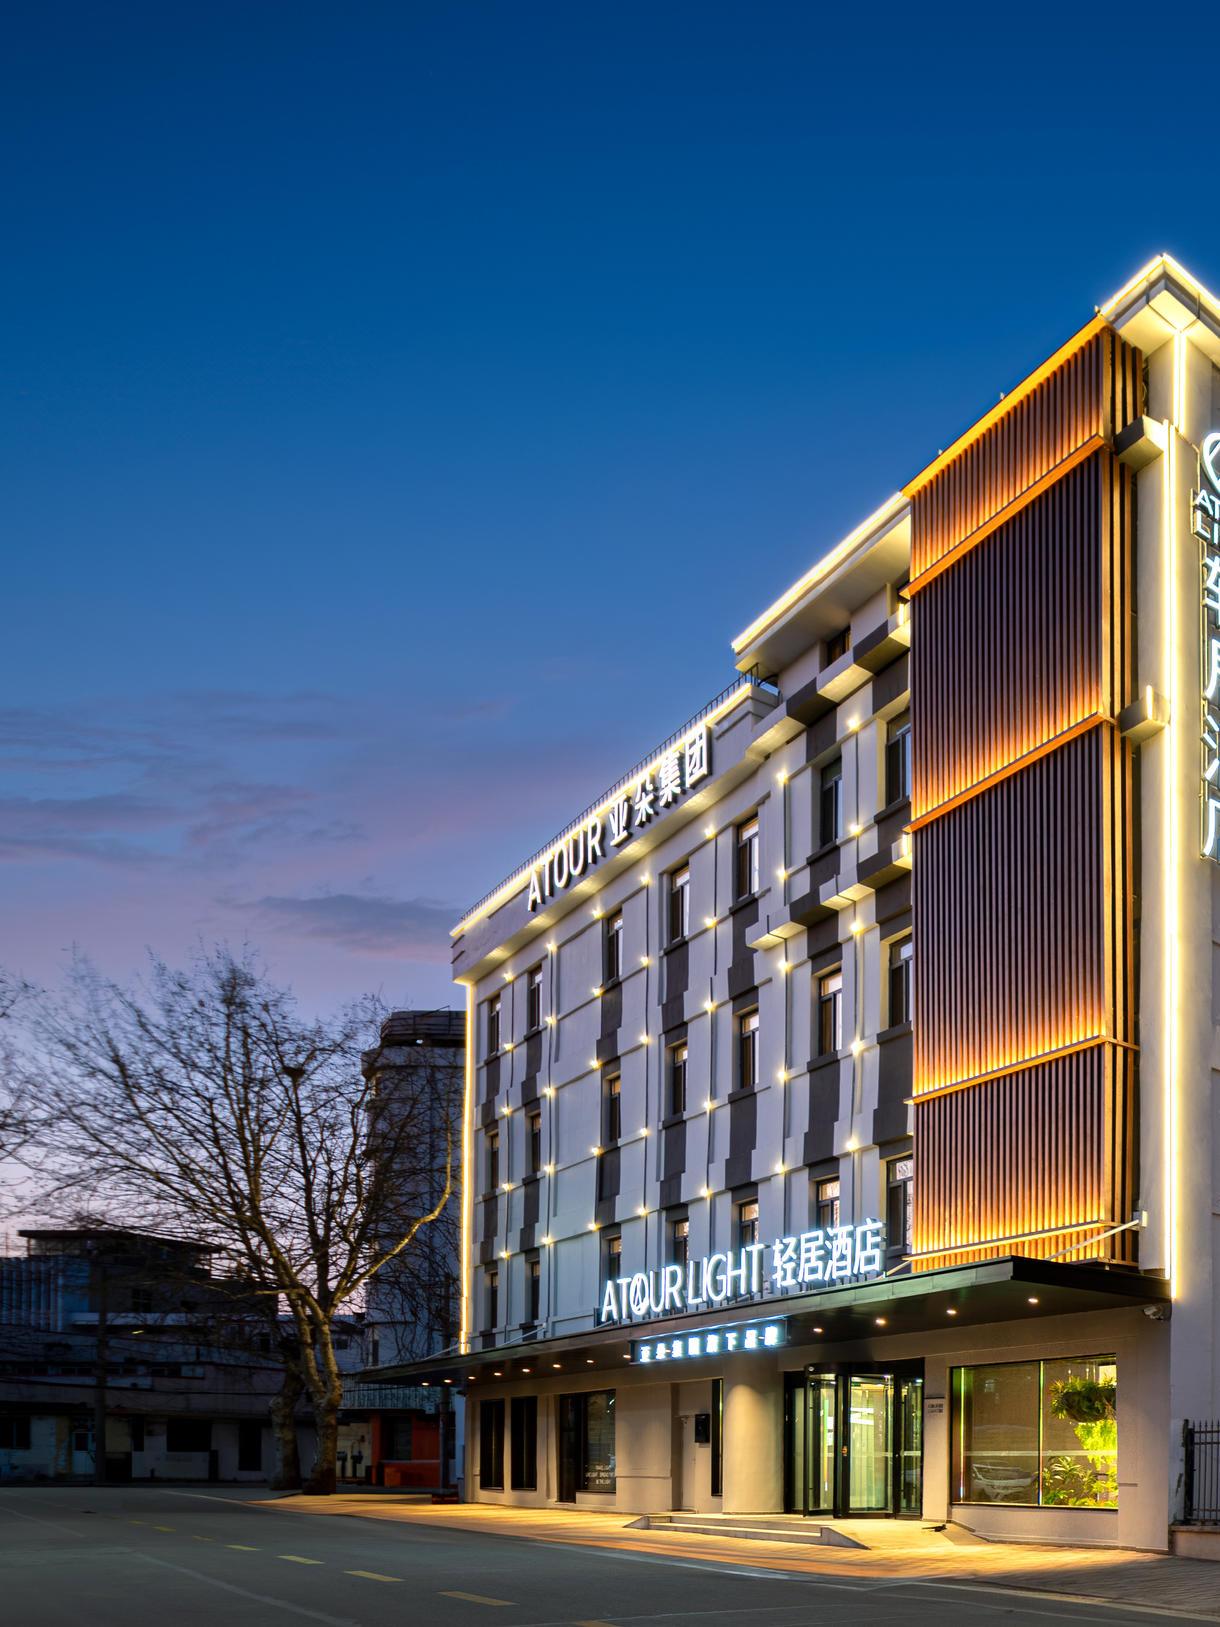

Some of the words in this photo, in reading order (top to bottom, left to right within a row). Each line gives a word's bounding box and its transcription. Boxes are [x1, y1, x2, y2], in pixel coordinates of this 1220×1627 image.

[528, 815, 604, 912] ATOUR
[609, 725, 709, 847] 亚朵集团
[601, 1264, 682, 1322] ATOUR
[687, 1243, 766, 1304] LIGHT
[772, 1217, 884, 1288] 轻居酒店
